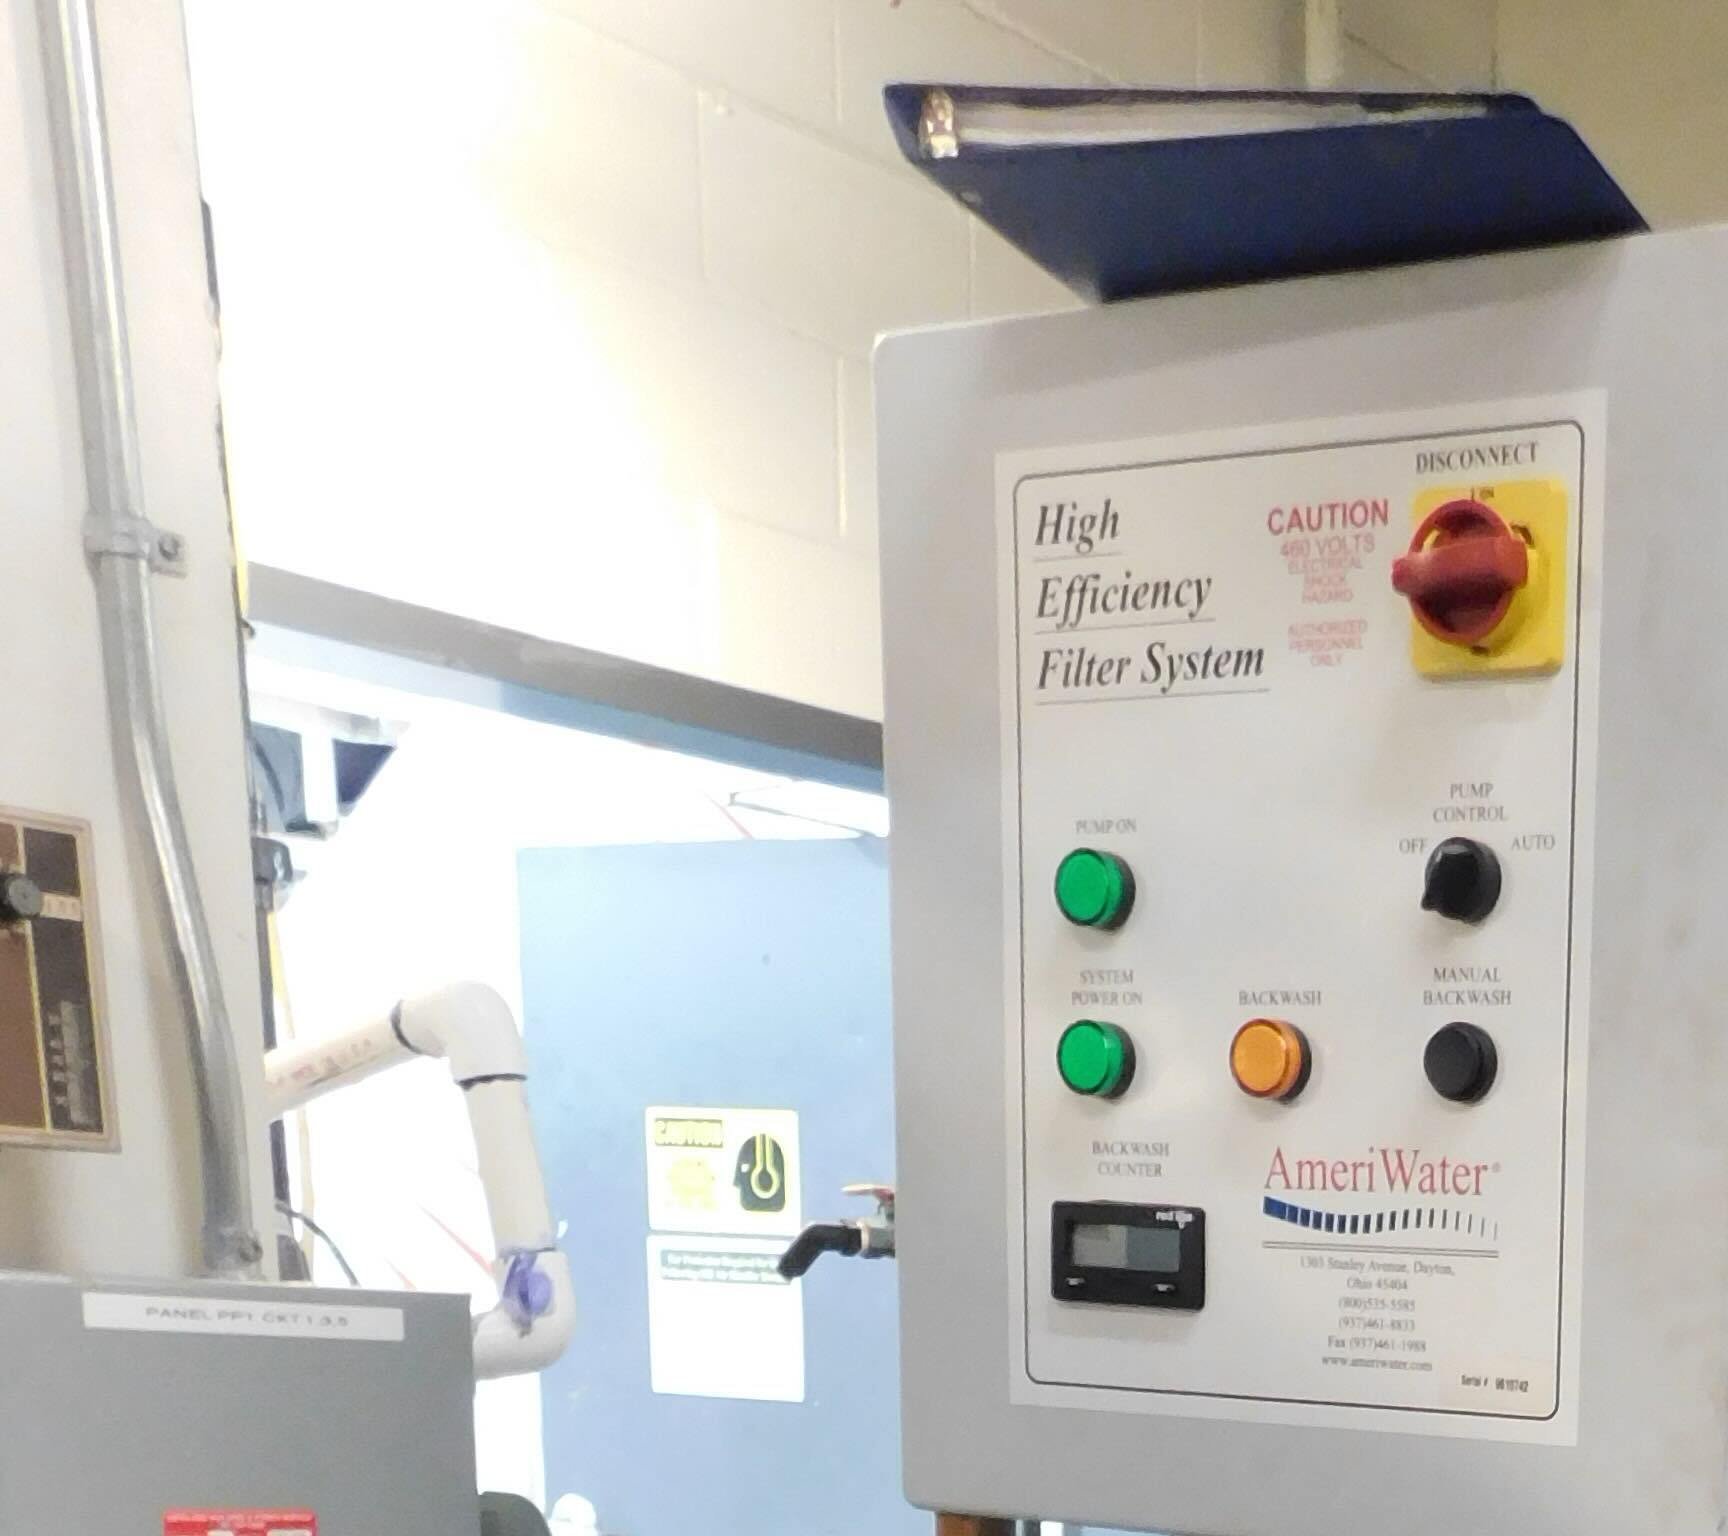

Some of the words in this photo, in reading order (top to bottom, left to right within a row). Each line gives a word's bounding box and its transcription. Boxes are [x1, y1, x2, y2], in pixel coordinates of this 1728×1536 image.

[1416, 440, 1538, 474] DISCONNECT
[1267, 498, 1389, 535] CAUTION
[1034, 498, 1119, 554] High
[1317, 531, 1375, 556] VOLTS
[1036, 570, 1212, 630] Efficiency
[1038, 647, 1131, 690] Filter
[1140, 641, 1264, 694] System
[1450, 782, 1494, 799] PUMP
[1432, 805, 1508, 823] CONTROL
[1115, 818, 1137, 834] ON
[1399, 837, 1428, 854] OFF
[1511, 834, 1556, 851] AUTO
[1079, 968, 1134, 984] SYSTEM
[1433, 967, 1502, 983] MANUAL
[1071, 991, 1120, 1006] POWER
[1122, 991, 1143, 1006] ON
[1238, 990, 1322, 1006] BACKWASH
[1423, 989, 1512, 1006] BACKWASH
[1092, 1141, 1170, 1157] BACKWASH
[1097, 1162, 1163, 1178] COUNTER
[1264, 1146, 1489, 1196] AmeriWater
